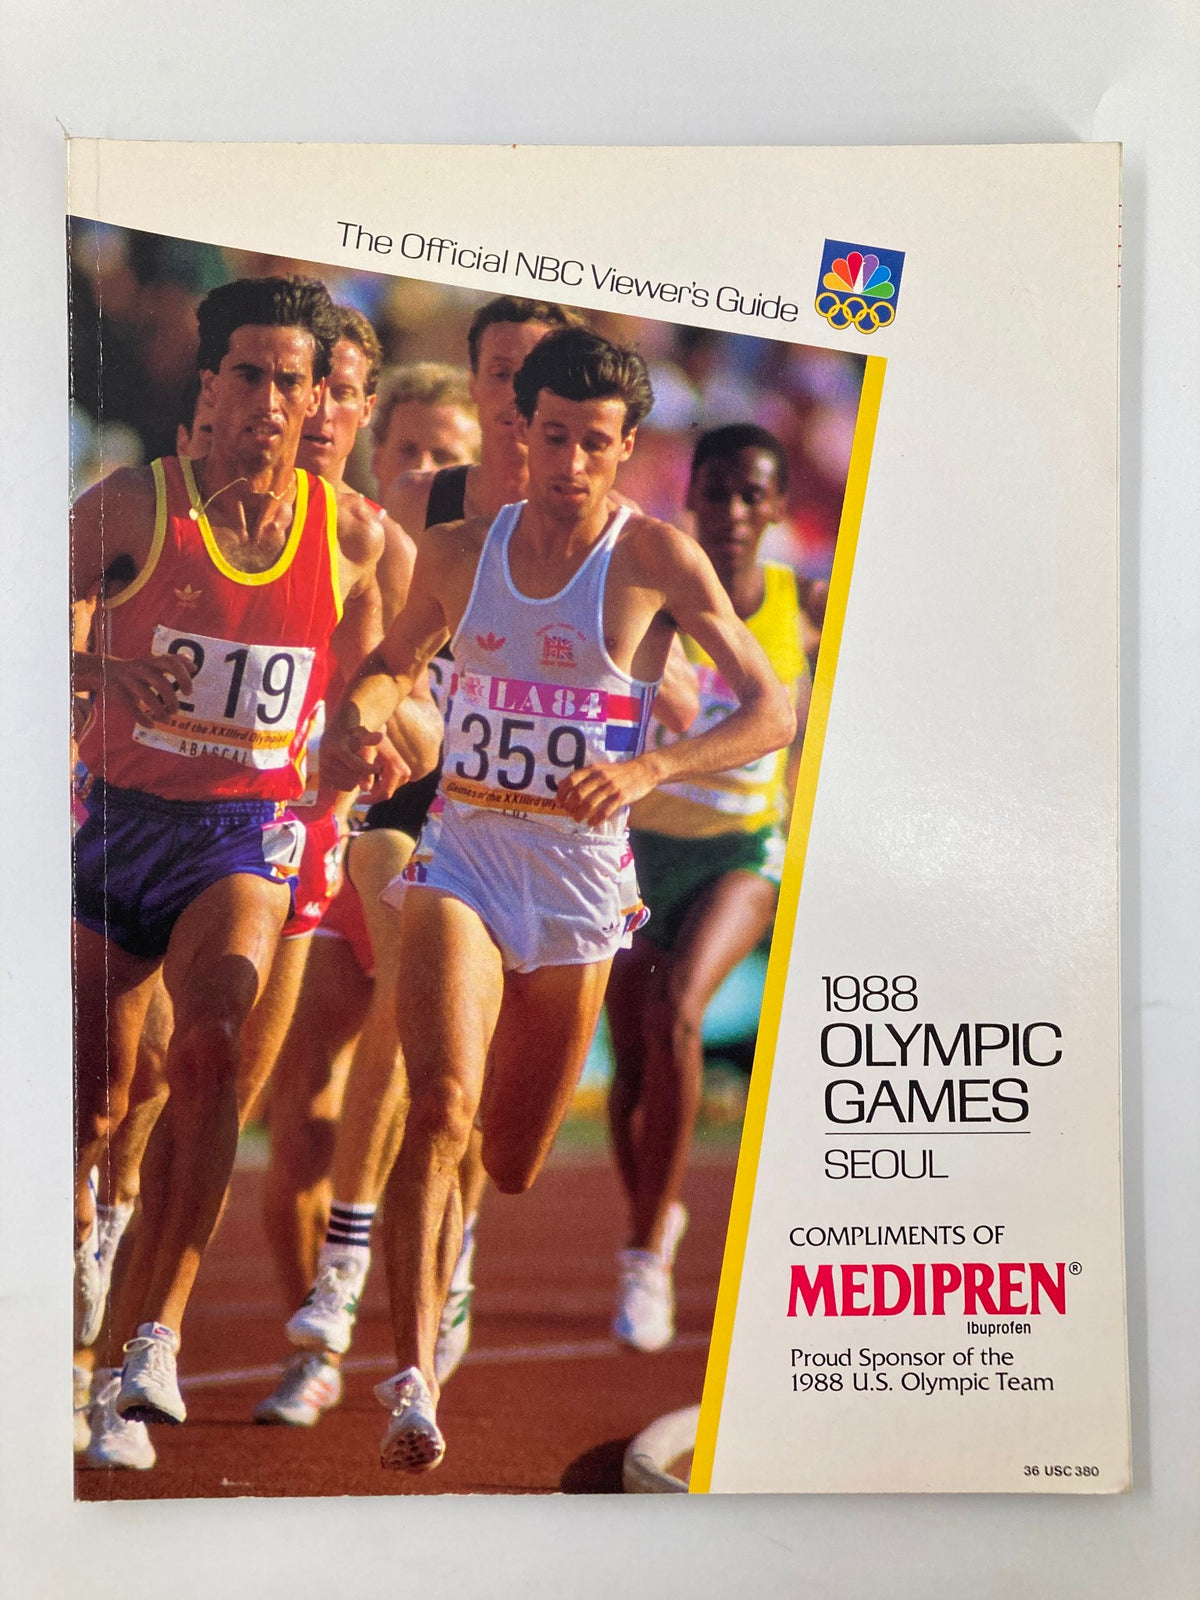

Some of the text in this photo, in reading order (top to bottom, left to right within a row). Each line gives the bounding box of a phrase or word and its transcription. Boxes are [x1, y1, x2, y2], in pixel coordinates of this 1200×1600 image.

[337, 221, 799, 323] The Official NBC Viewer's Guide
[166, 637, 295, 724] 219
[494, 680, 602, 720] LA 84
[455, 712, 587, 793] 359
[821, 974, 919, 1013] 1988
[820, 1021, 1063, 1068] OLYMPIC
[824, 1077, 1030, 1124] GAMES
[824, 1149, 949, 1180] SEOUL
[789, 1225, 1006, 1247] COMPLIMENTS OF
[966, 1320, 1032, 1338] Ibuprofen
[790, 1347, 1014, 1371] Proud Sponsor of the
[791, 1372, 1054, 1396] 1988 U.S. Olympic Team
[1023, 1465, 1100, 1477] 36 USC 380
